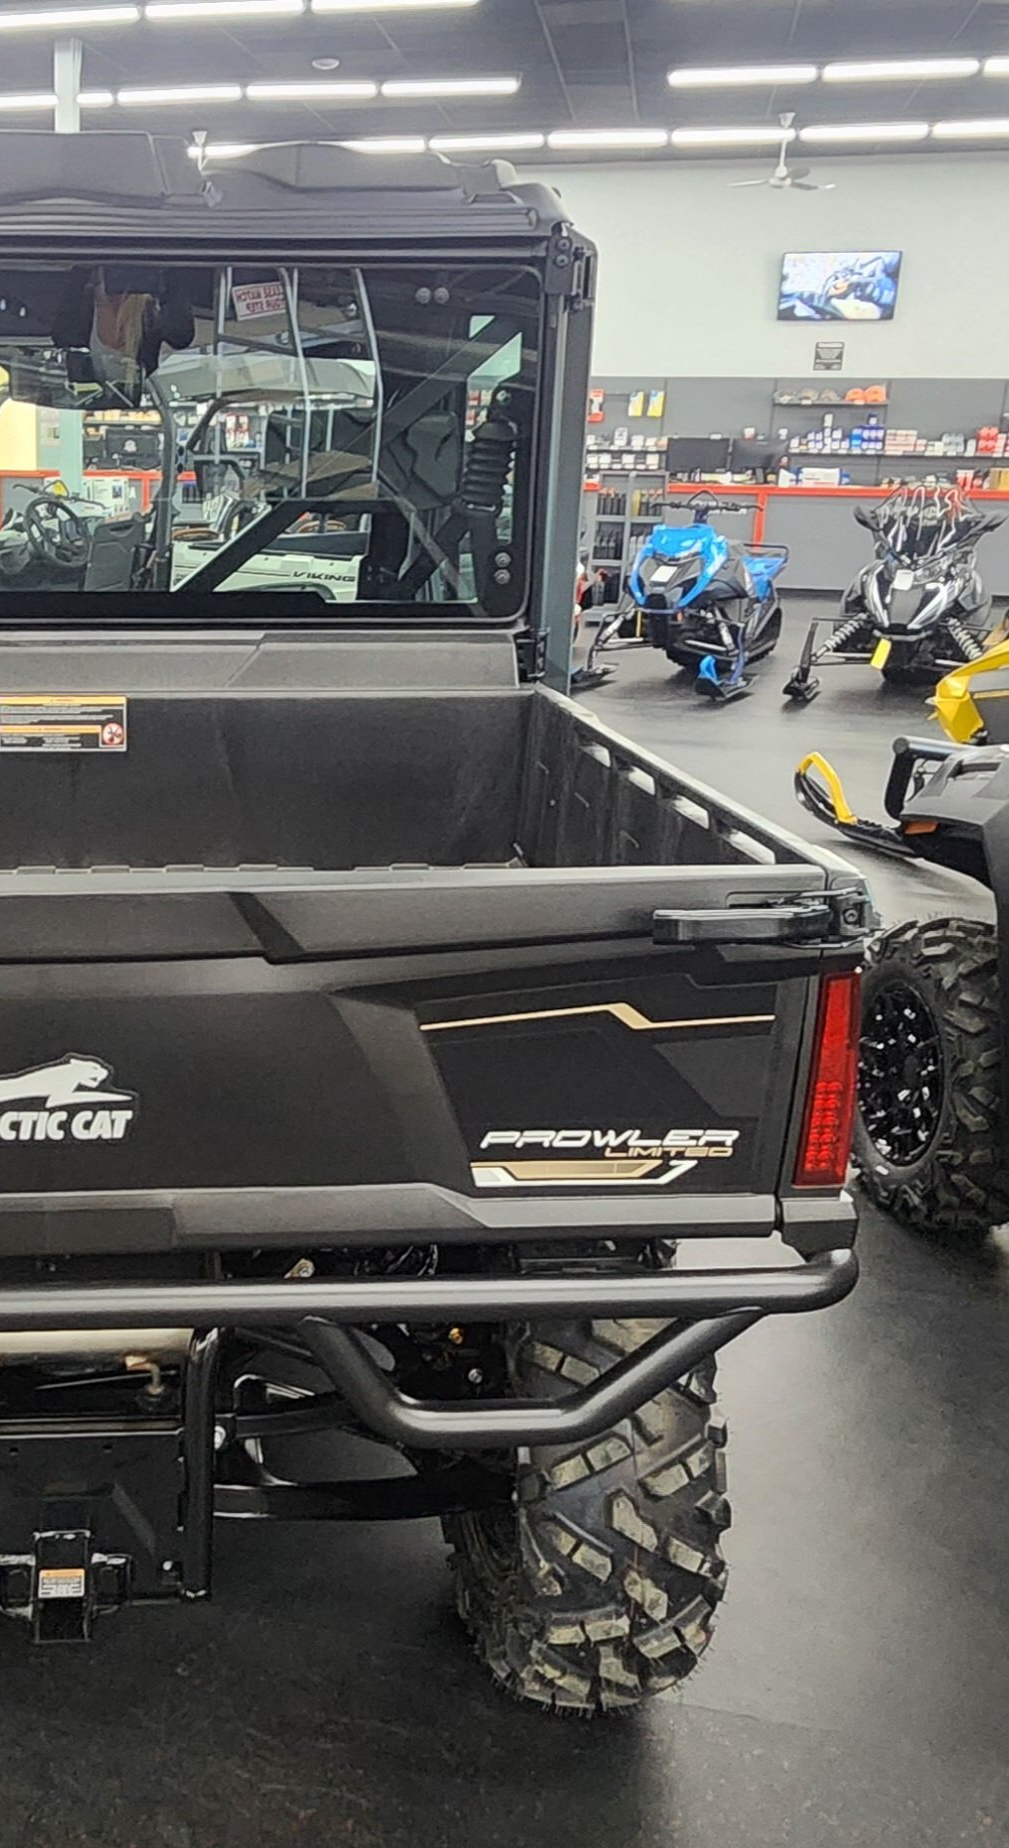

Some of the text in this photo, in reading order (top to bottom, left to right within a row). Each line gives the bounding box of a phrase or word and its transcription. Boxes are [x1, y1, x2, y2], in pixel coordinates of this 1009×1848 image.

[293, 571, 356, 582] VIKING
[71, 1110, 133, 1139] CAT
[480, 1129, 739, 1149] PROWLER
[605, 1147, 733, 1158] LIMITED
